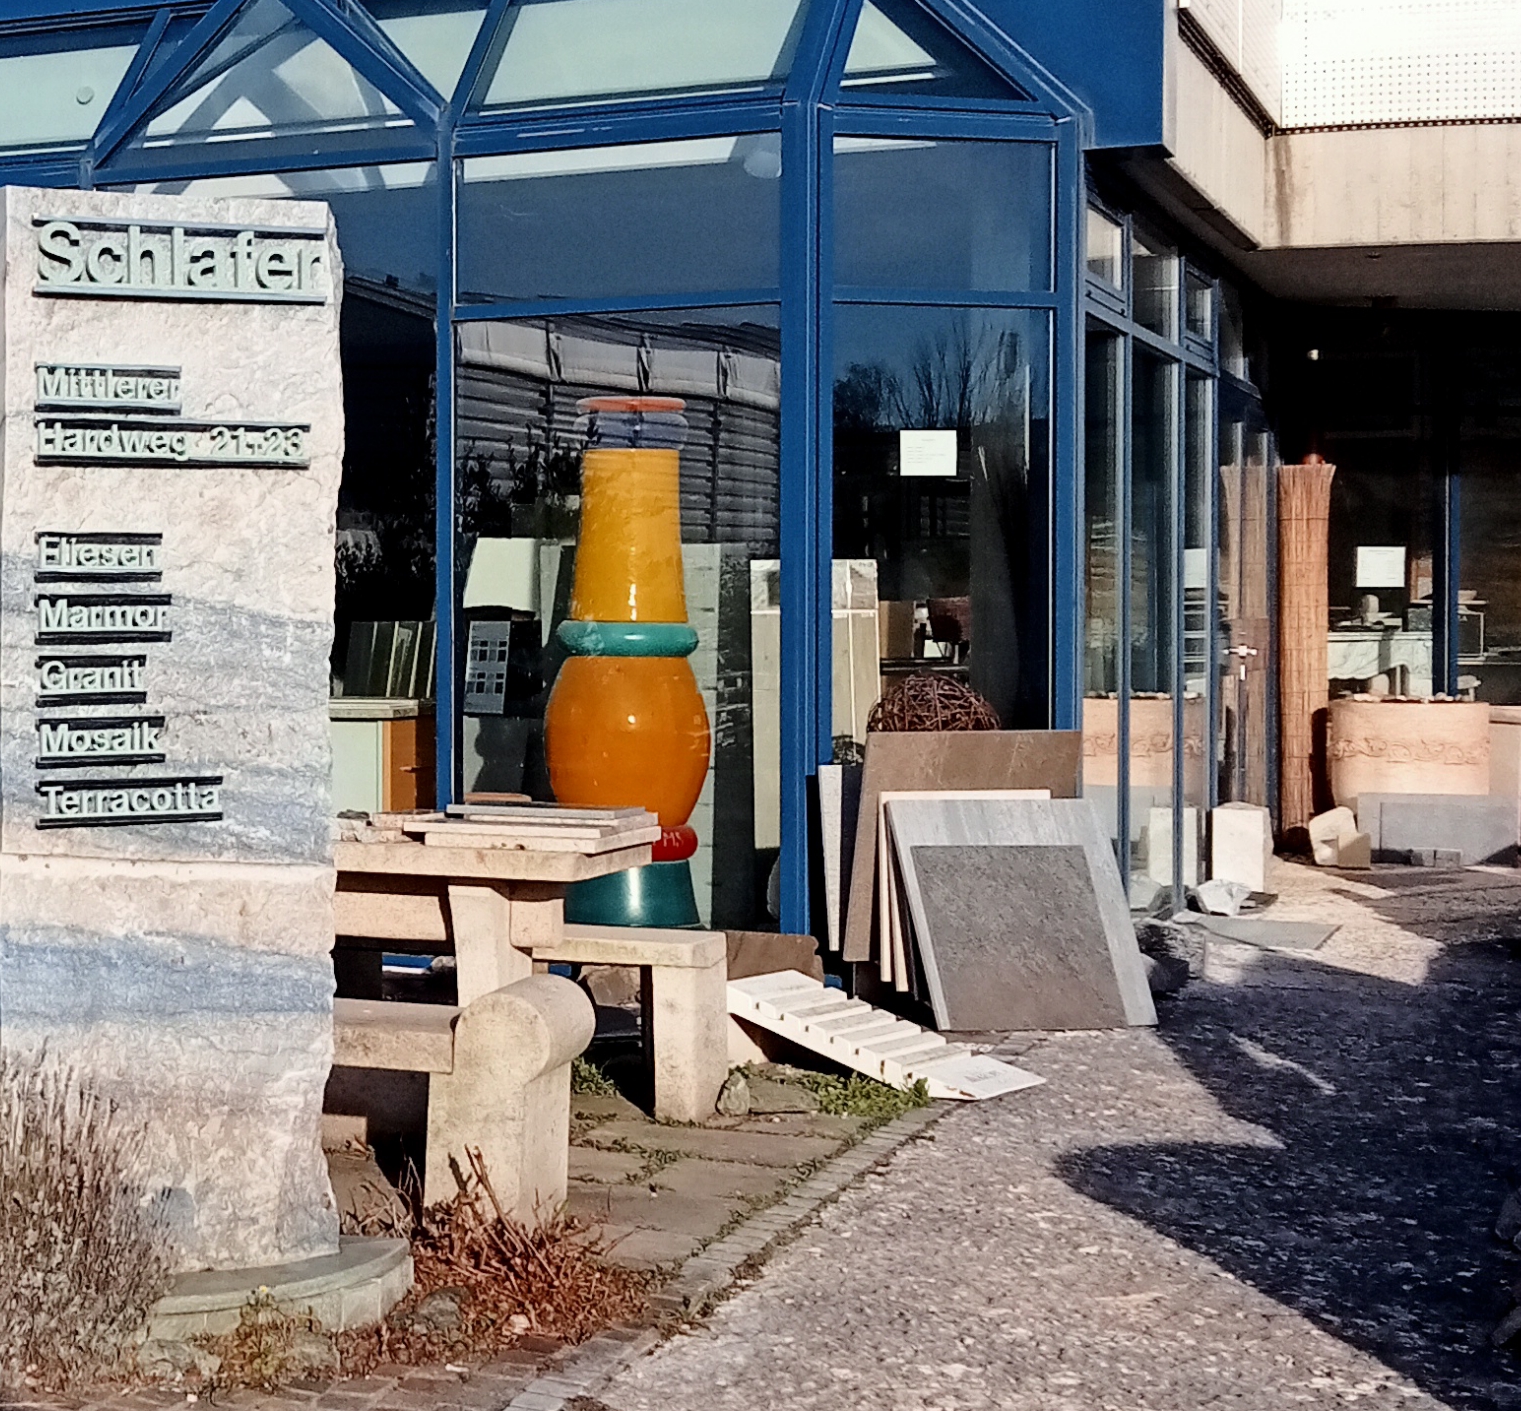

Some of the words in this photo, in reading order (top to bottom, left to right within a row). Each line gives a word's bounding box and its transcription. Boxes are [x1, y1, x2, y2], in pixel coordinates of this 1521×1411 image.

[38, 221, 323, 290] Schlafer
[37, 367, 180, 401] Mittlerer
[38, 422, 188, 461] Hardweg
[209, 426, 304, 458] 21-23
[39, 537, 157, 568] Fliesen
[39, 598, 168, 630] Marmor
[41, 660, 143, 691] Granit
[40, 721, 161, 754] Mosaik
[40, 783, 221, 816] Terracotta
